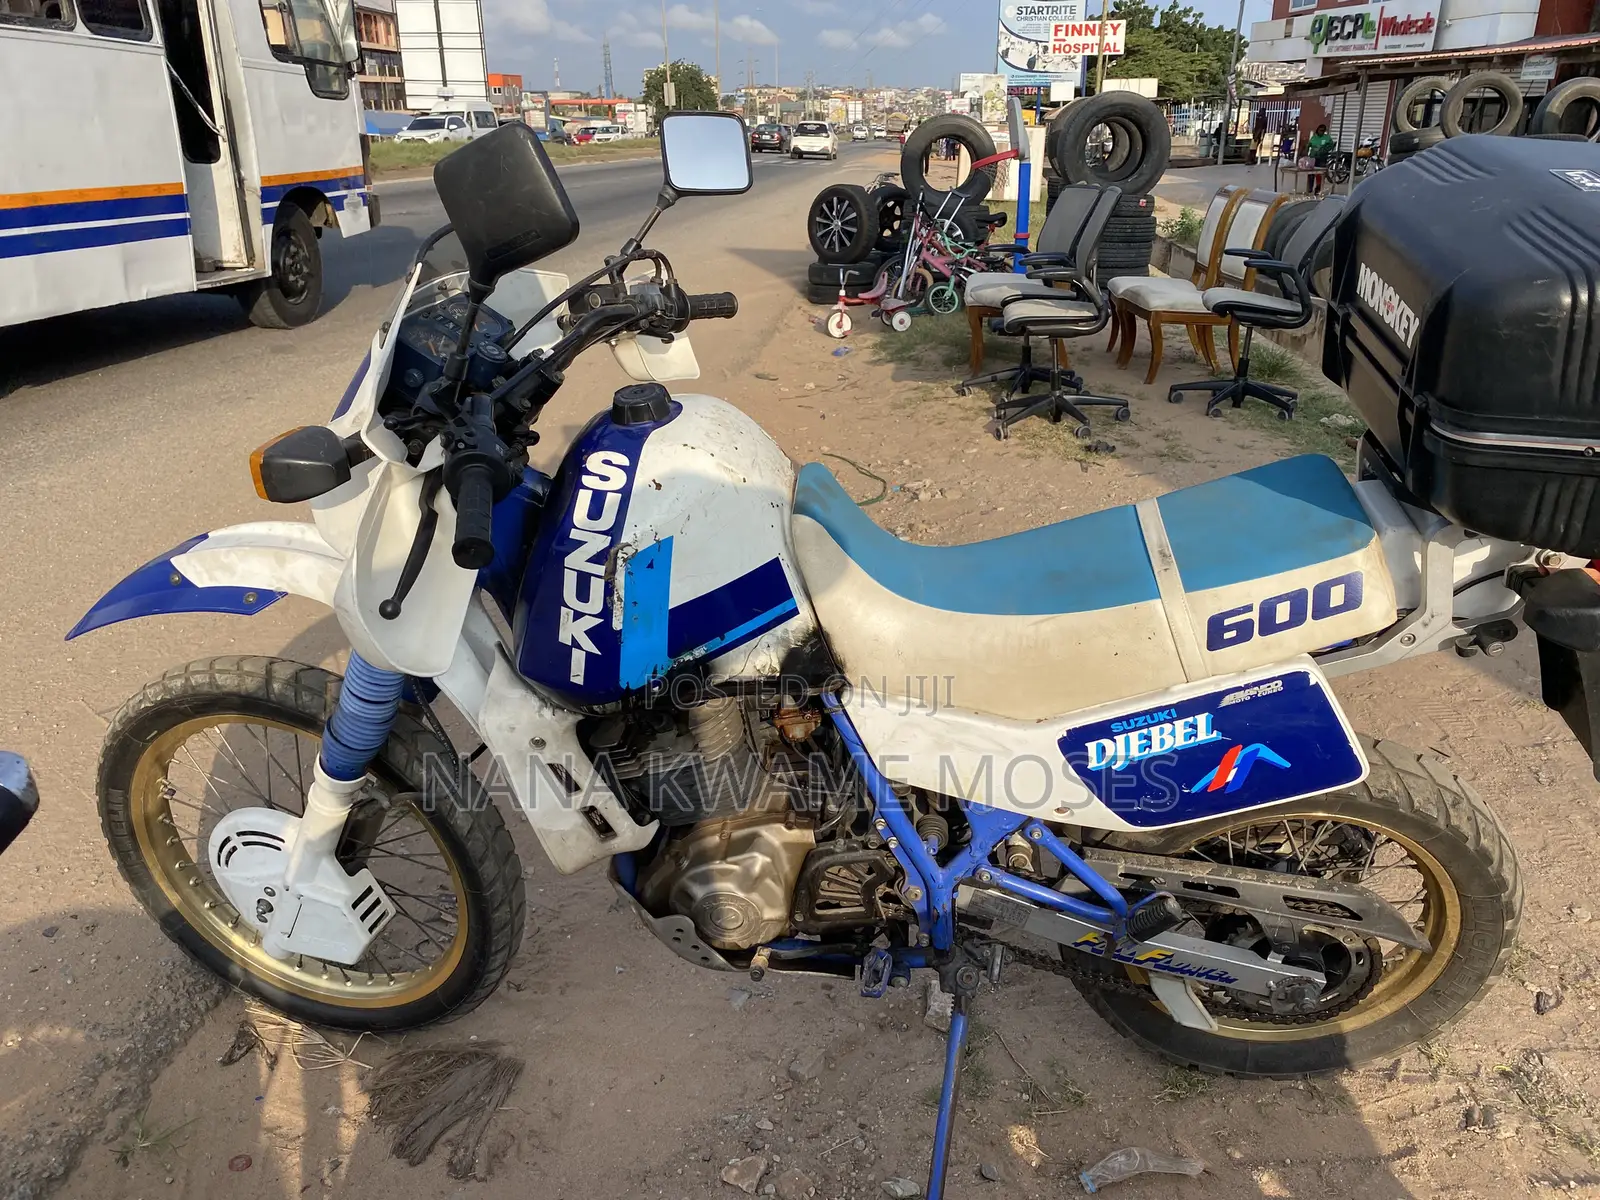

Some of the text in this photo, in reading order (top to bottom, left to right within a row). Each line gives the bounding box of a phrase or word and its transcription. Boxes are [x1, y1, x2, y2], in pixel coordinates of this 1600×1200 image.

[1016, 5, 1077, 16] STARTRITE
[1053, 23, 1121, 37] FINNEY
[1381, 12, 1435, 37] Wholesale
[1356, 262, 1420, 349] MONOKEY
[559, 450, 630, 686] SUZUKI
[1207, 570, 1364, 652] 600
[1110, 708, 1178, 733] SUZUKI
[1084, 712, 1222, 772] DJEBEL
